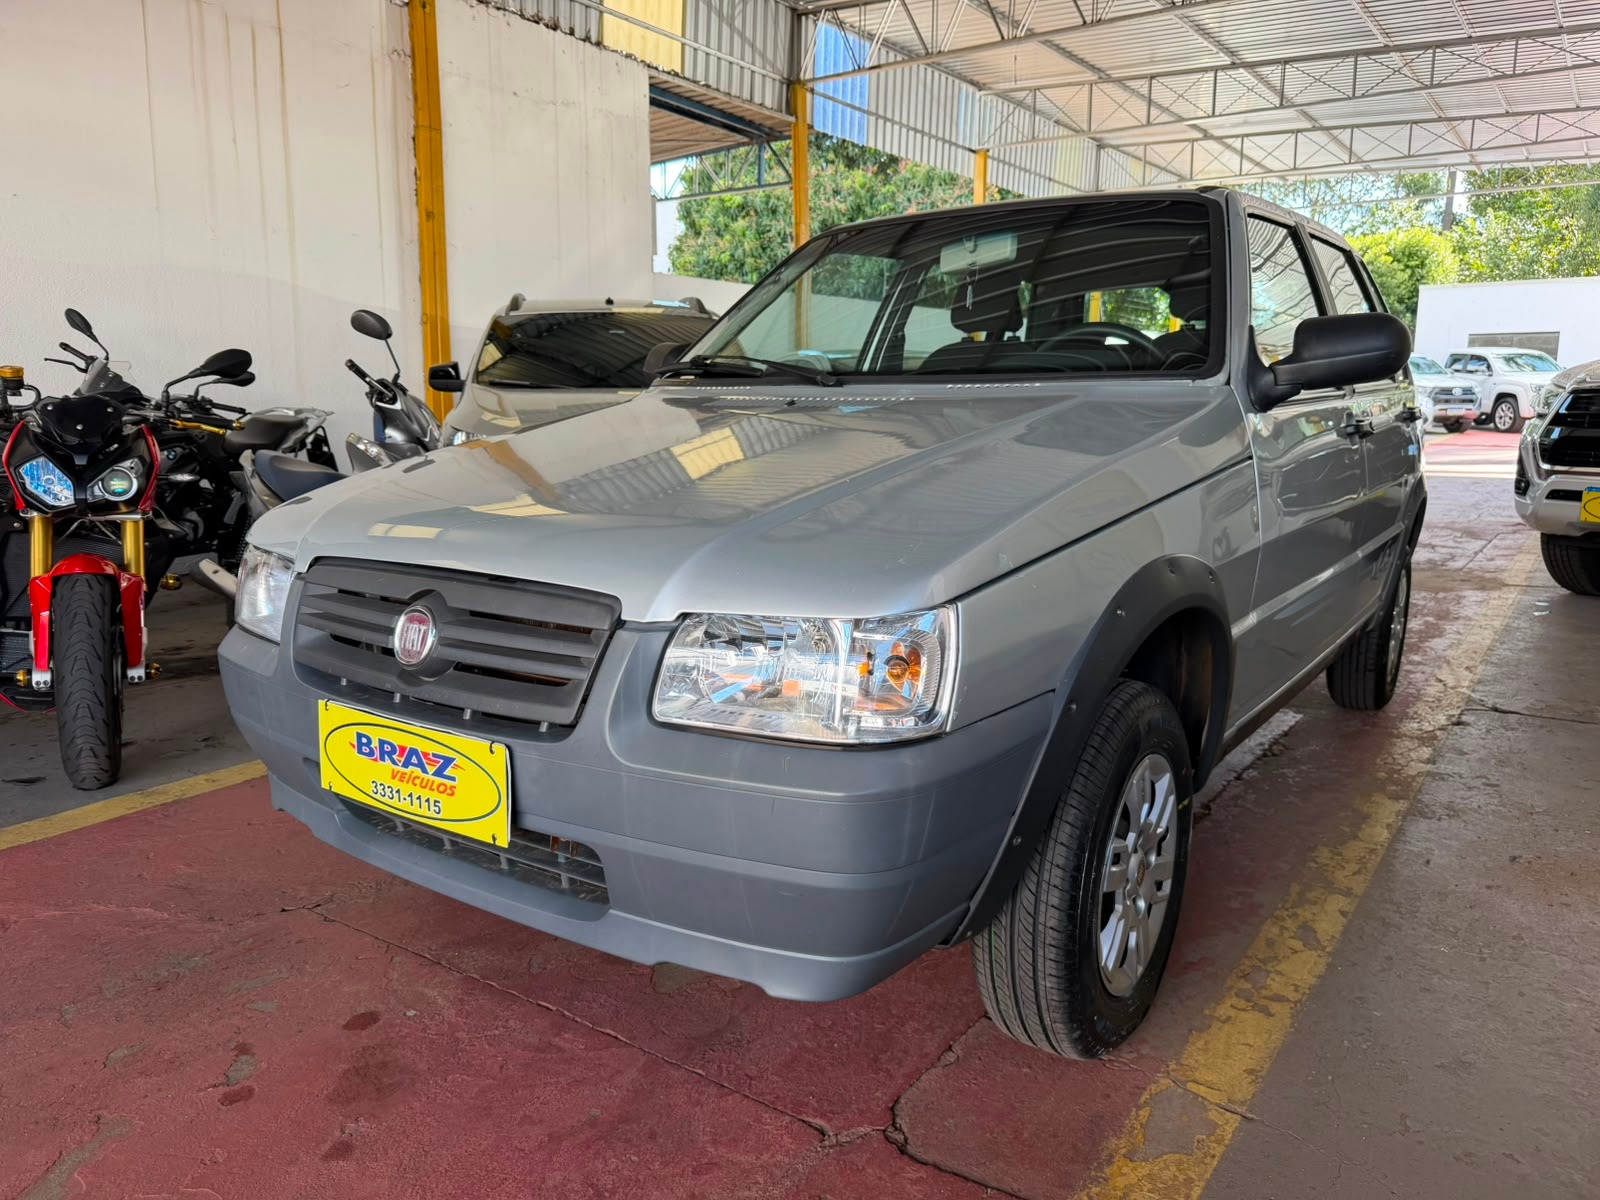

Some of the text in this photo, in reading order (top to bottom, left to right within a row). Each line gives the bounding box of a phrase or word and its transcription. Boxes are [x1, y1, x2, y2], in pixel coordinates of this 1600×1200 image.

[402, 623, 427, 651] FIAT
[355, 731, 457, 783] BRAZ
[371, 780, 442, 815] 3331-1115
[390, 768, 457, 797] VEÍCULOS
